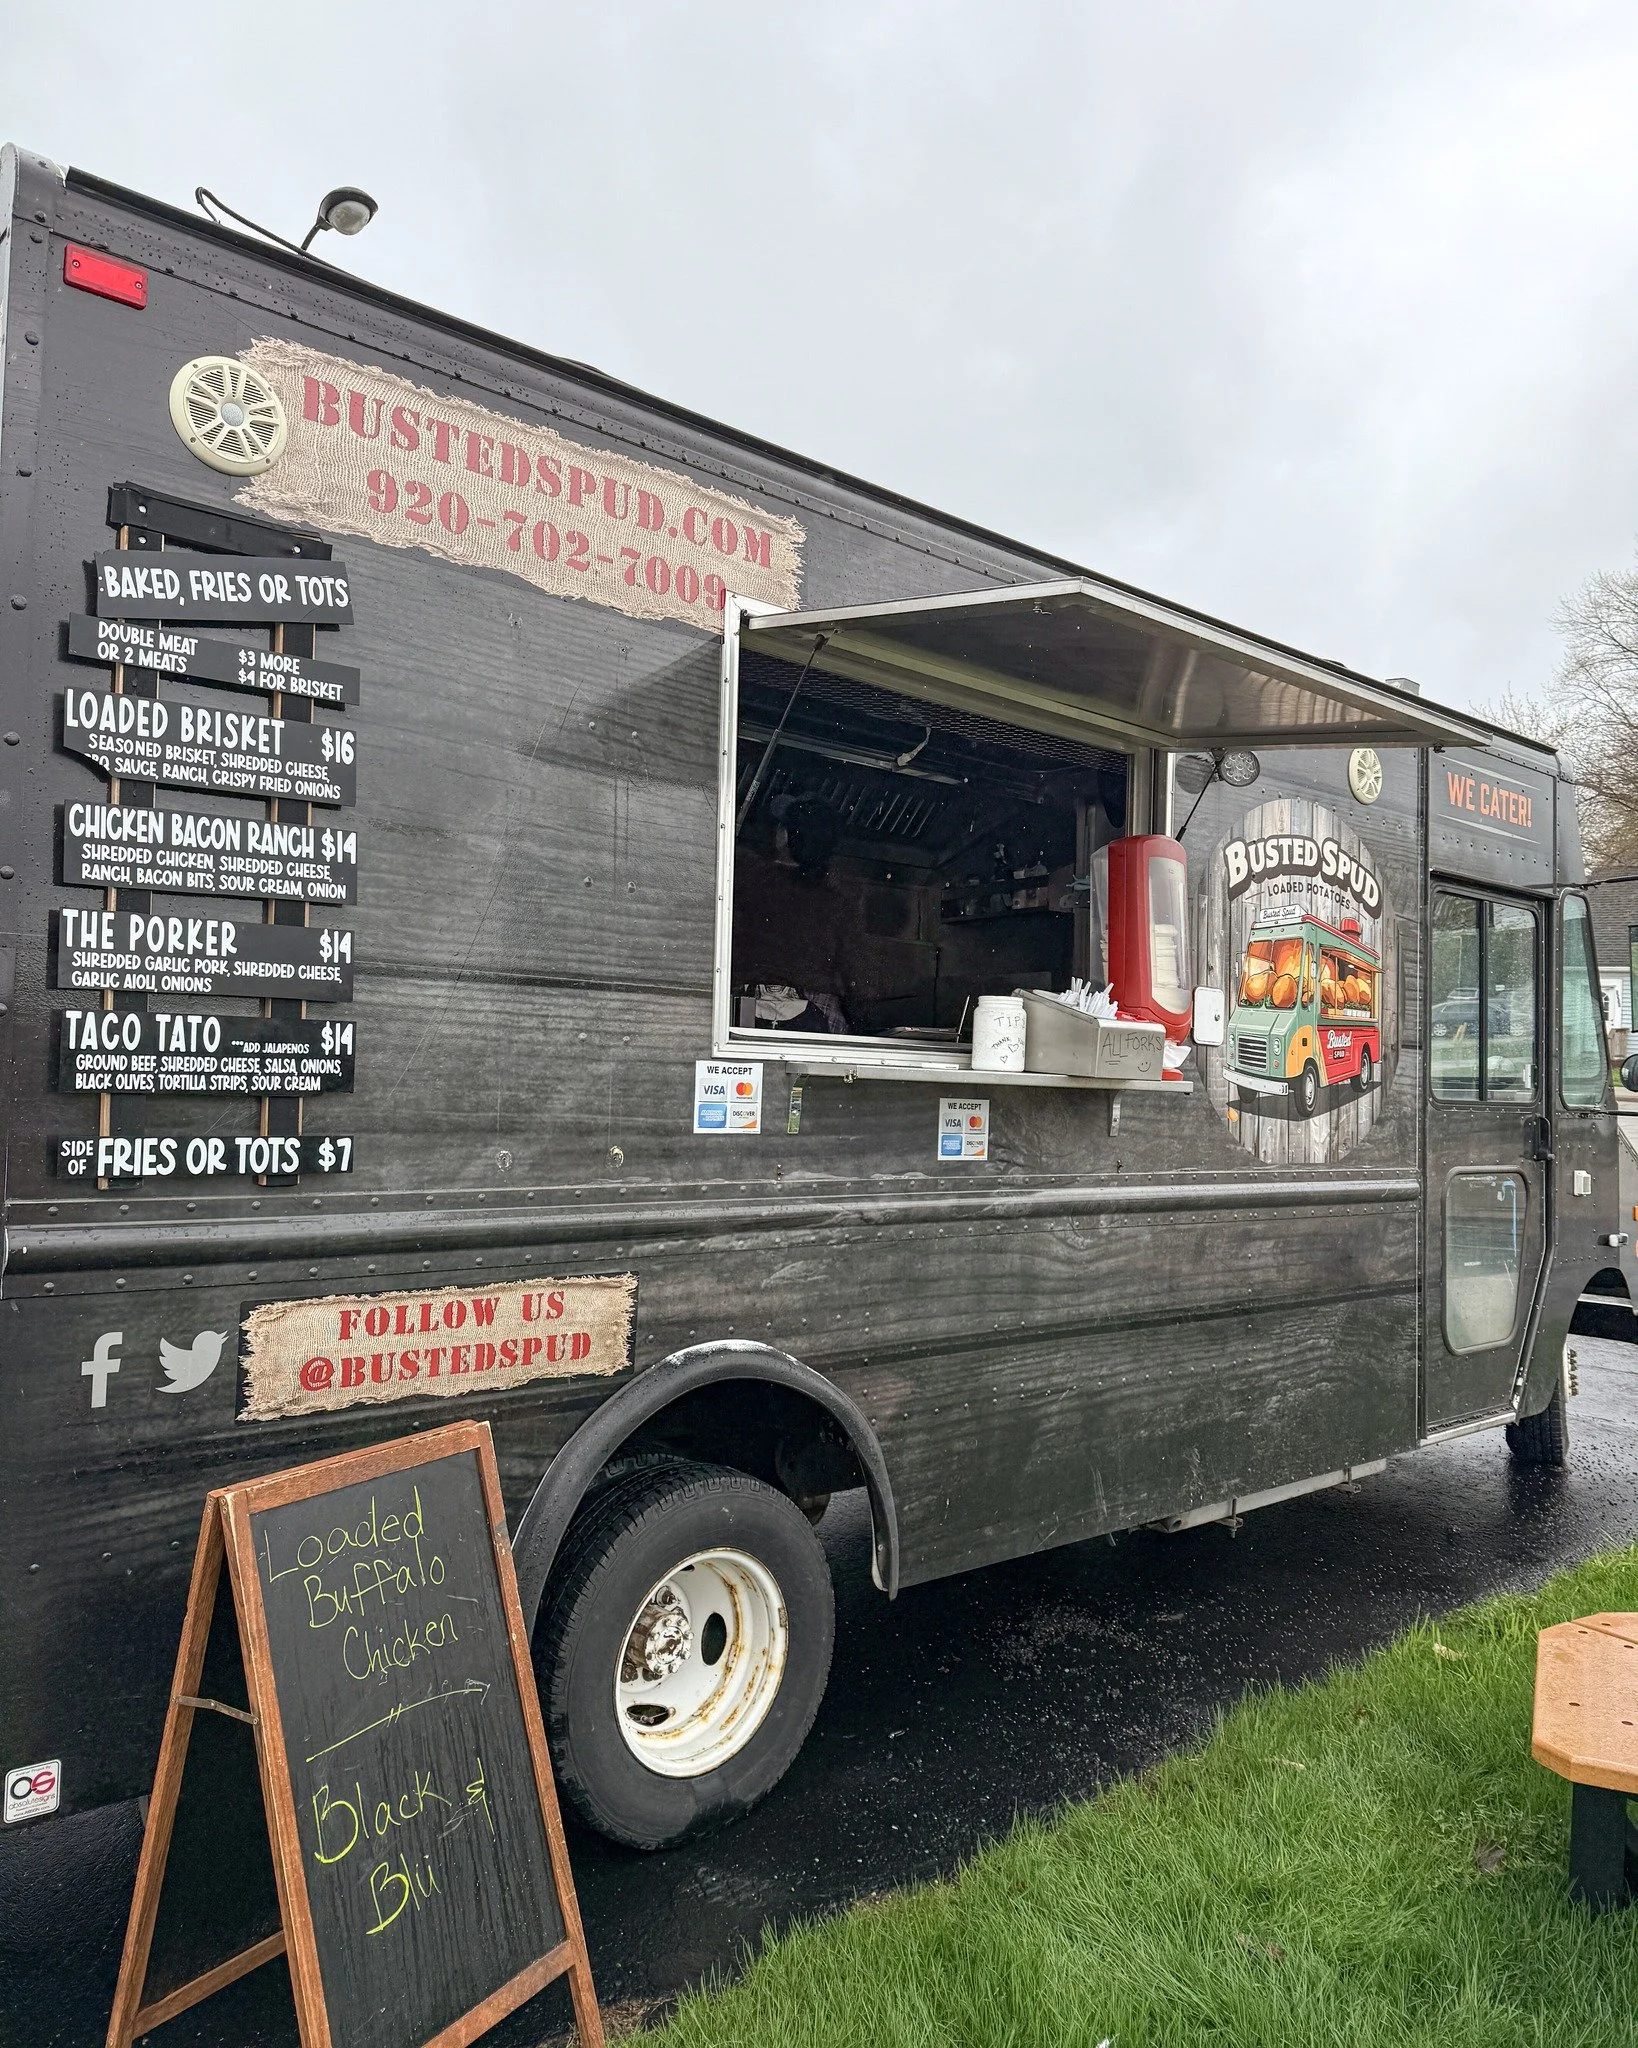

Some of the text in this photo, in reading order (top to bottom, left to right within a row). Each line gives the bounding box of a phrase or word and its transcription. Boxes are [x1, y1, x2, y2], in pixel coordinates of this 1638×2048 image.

[301, 375, 773, 569] BUSTEDSPUD.COM
[365, 469, 727, 611] 920-702-7009
[188, 570, 251, 603] FRIES
[258, 573, 291, 604] OR
[294, 575, 350, 608] TOTS
[97, 621, 199, 656] DOUBLE MEAT
[97, 641, 188, 674] OR 2 MEATS
[238, 649, 300, 675] $3 MORE
[238, 668, 344, 701] $4 FOR BRISKET
[66, 688, 356, 765] LOADED BRISKET $16
[83, 753, 341, 800] BQ SAUCE, RANCH, CRISPY FRIED ONIONS
[88, 733, 330, 784] SEASONED BRISKET, SHREDDED CHEESE,
[1447, 771, 1533, 829] WE CATER!
[68, 802, 357, 865] CHICKEN BACON RANCH $14
[81, 843, 333, 883] SHREDDED CHICKEN, SHREDDED CHEESE,
[81, 863, 347, 899] RANCH, BACON BITS, SOUR CREAM, ONION
[1224, 835, 1381, 909] BUSTED SPUD
[1262, 906, 1297, 920] Busted Spud
[1267, 881, 1351, 910] LOADED POTATOES
[62, 908, 352, 964] THE PORKER $14
[71, 952, 343, 984] SHREDDED GARLIC PORK, SHREDDED CHEESE,
[71, 971, 213, 993] GARLIC AIOLI, ONIONS
[65, 1010, 142, 1051] TACO
[155, 1013, 222, 1053] TATO
[262, 1043, 310, 1054] JALAPENOS
[320, 1020, 353, 1055] $14
[1100, 1032, 1163, 1058] ALL FORKS
[1327, 1029, 1353, 1049] Busted
[75, 1054, 342, 1077] GROUND BEEF, SHREDDED CHEESE, SALSA, ONIONS,
[75, 1073, 321, 1094] BLACK OLIVES, TORTILLA STRIPS, SOUR CREAM
[707, 1066, 753, 1076] WE ACCEPT
[703, 1085, 726, 1095] VISA
[947, 1102, 982, 1111] WE ACCEPT
[945, 1118, 962, 1128] VISA
[60, 1140, 94, 1157] SIDE
[67, 1159, 88, 1175] OF
[97, 1136, 352, 1177] FRIES OR TOTS $7
[337, 1290, 566, 1342] FOLLOW US
[299, 1330, 592, 1392] @BUSTEDSPUD
[263, 1485, 425, 1584] Loaded
[303, 1536, 445, 1629] Buffalo
[343, 1613, 459, 1680] Chicken
[312, 1770, 452, 1864] Black
